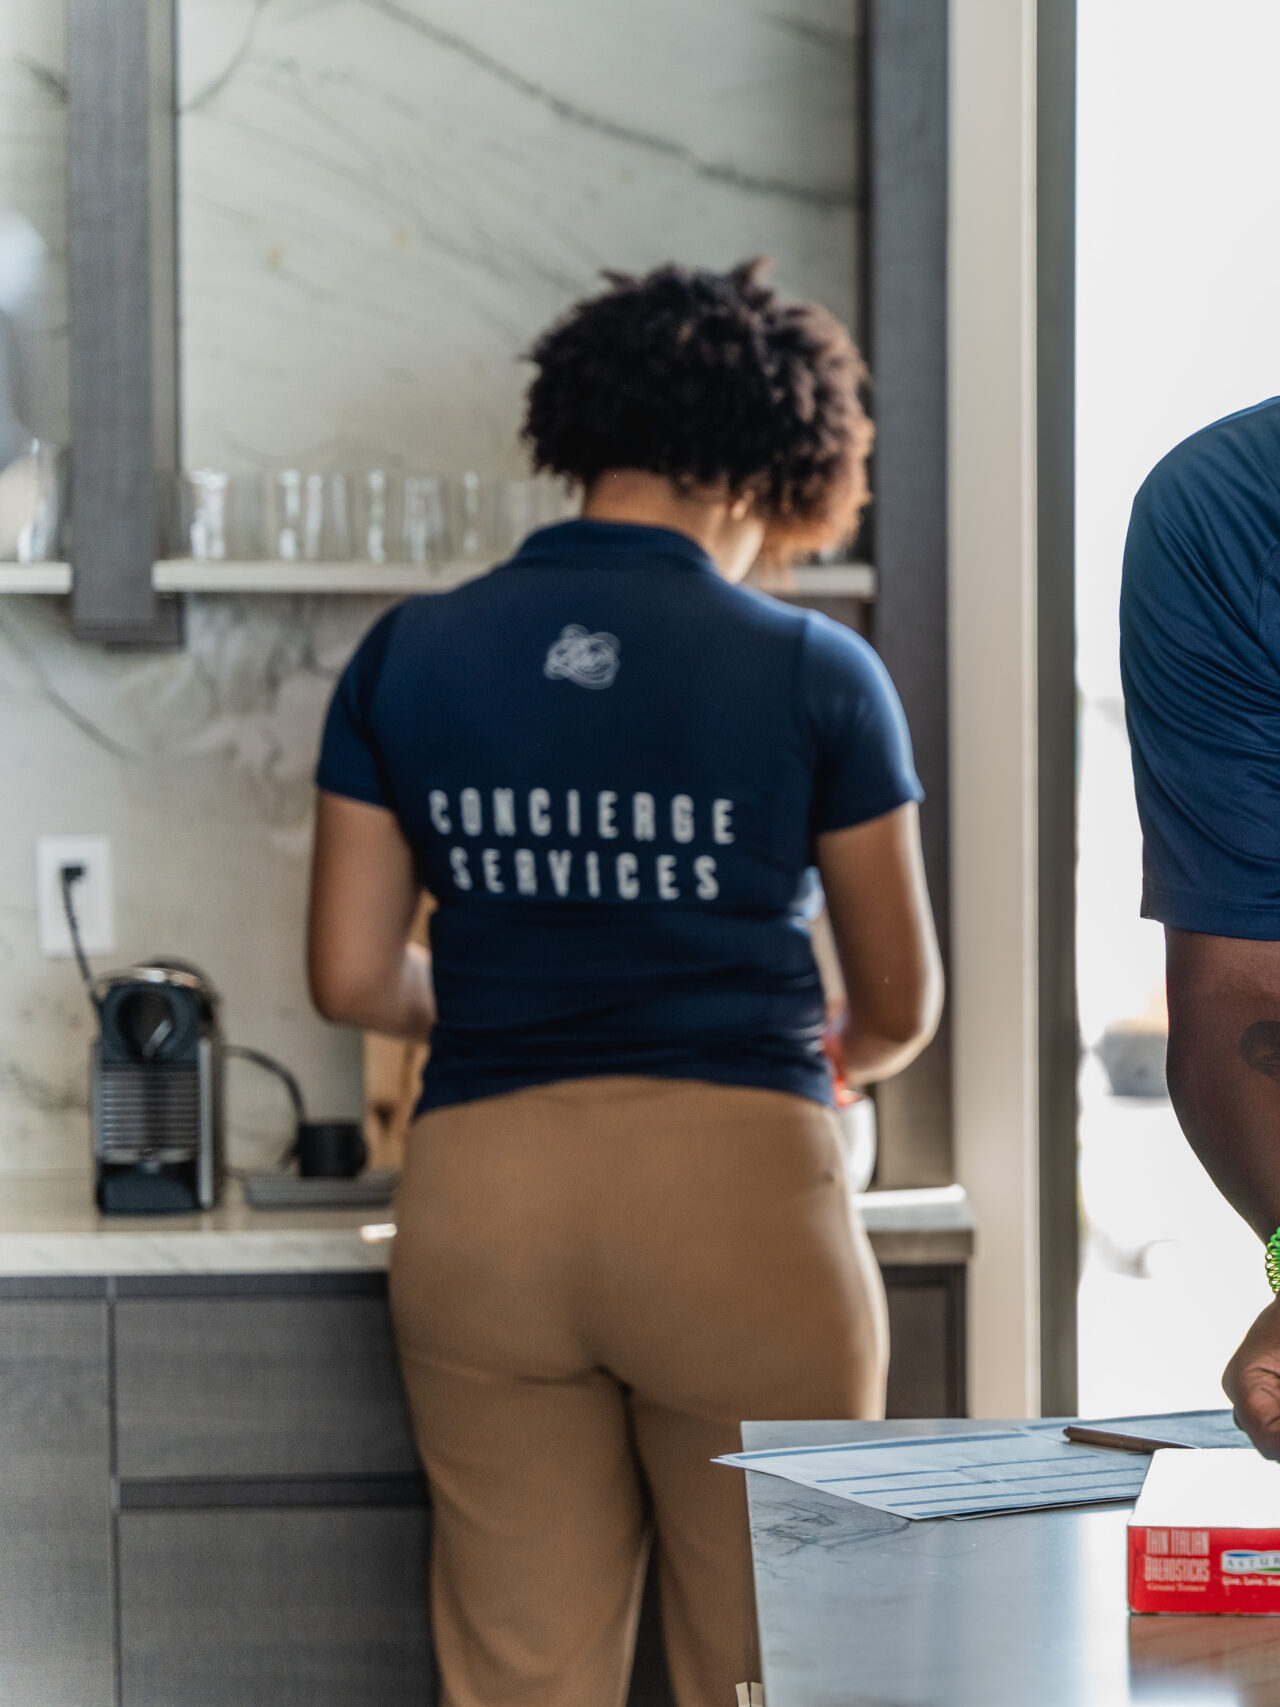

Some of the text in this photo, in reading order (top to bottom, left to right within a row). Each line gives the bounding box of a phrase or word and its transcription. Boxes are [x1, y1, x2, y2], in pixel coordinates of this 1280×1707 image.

[429, 787, 736, 845] CONCIERGE
[449, 846, 720, 901] SERVICES
[1145, 1528, 1209, 1556] THIN ITALIAN
